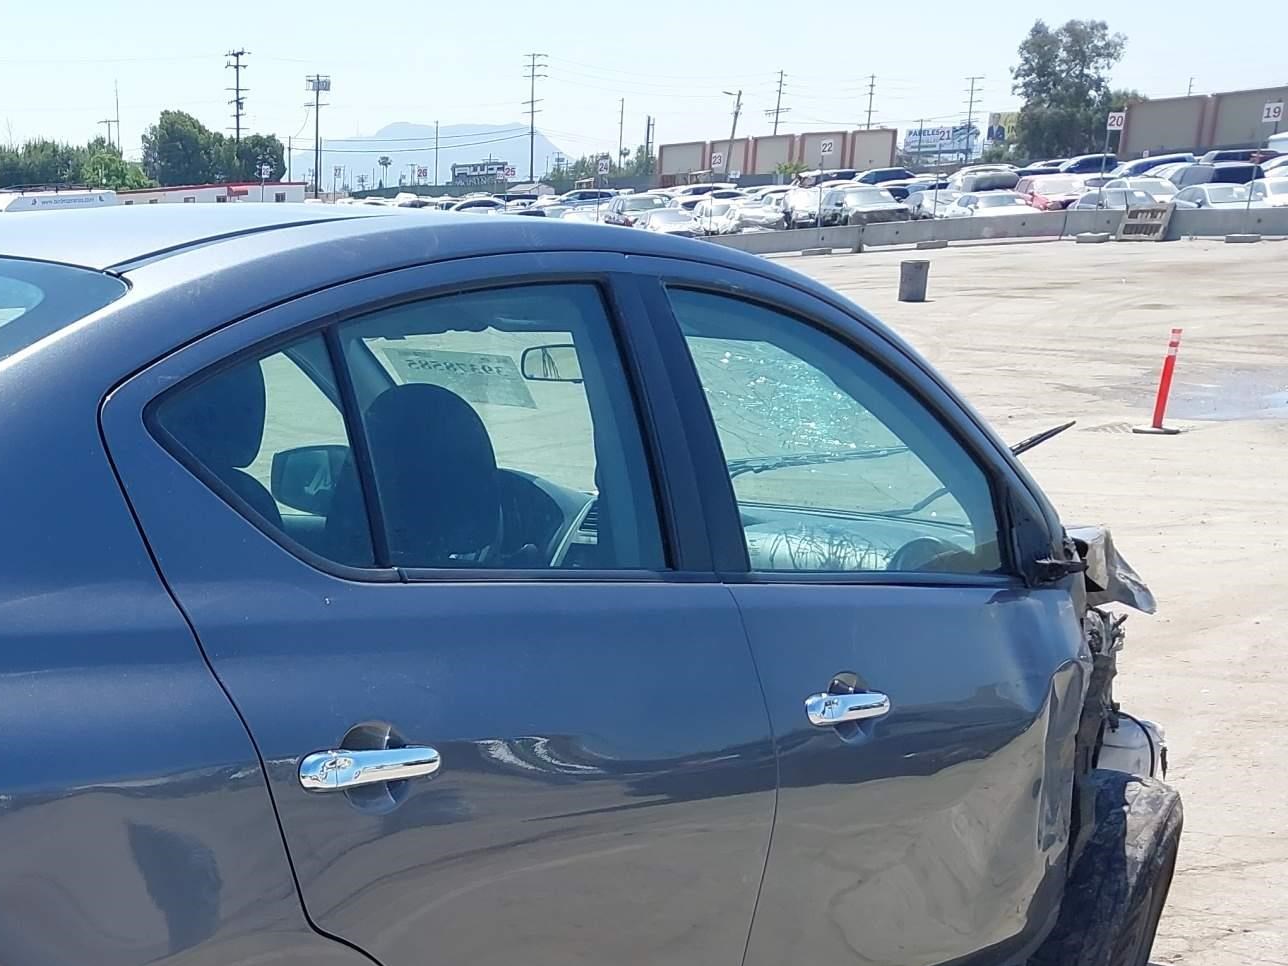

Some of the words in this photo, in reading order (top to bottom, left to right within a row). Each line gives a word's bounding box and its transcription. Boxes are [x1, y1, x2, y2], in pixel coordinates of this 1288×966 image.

[1264, 106, 1282, 119] 19
[1108, 115, 1124, 127] 20
[939, 130, 951, 141] 21
[821, 142, 833, 153] 22
[712, 155, 722, 165] 23
[505, 167, 516, 177] 25
[599, 162, 609, 172] 24
[417, 168, 428, 177] 26
